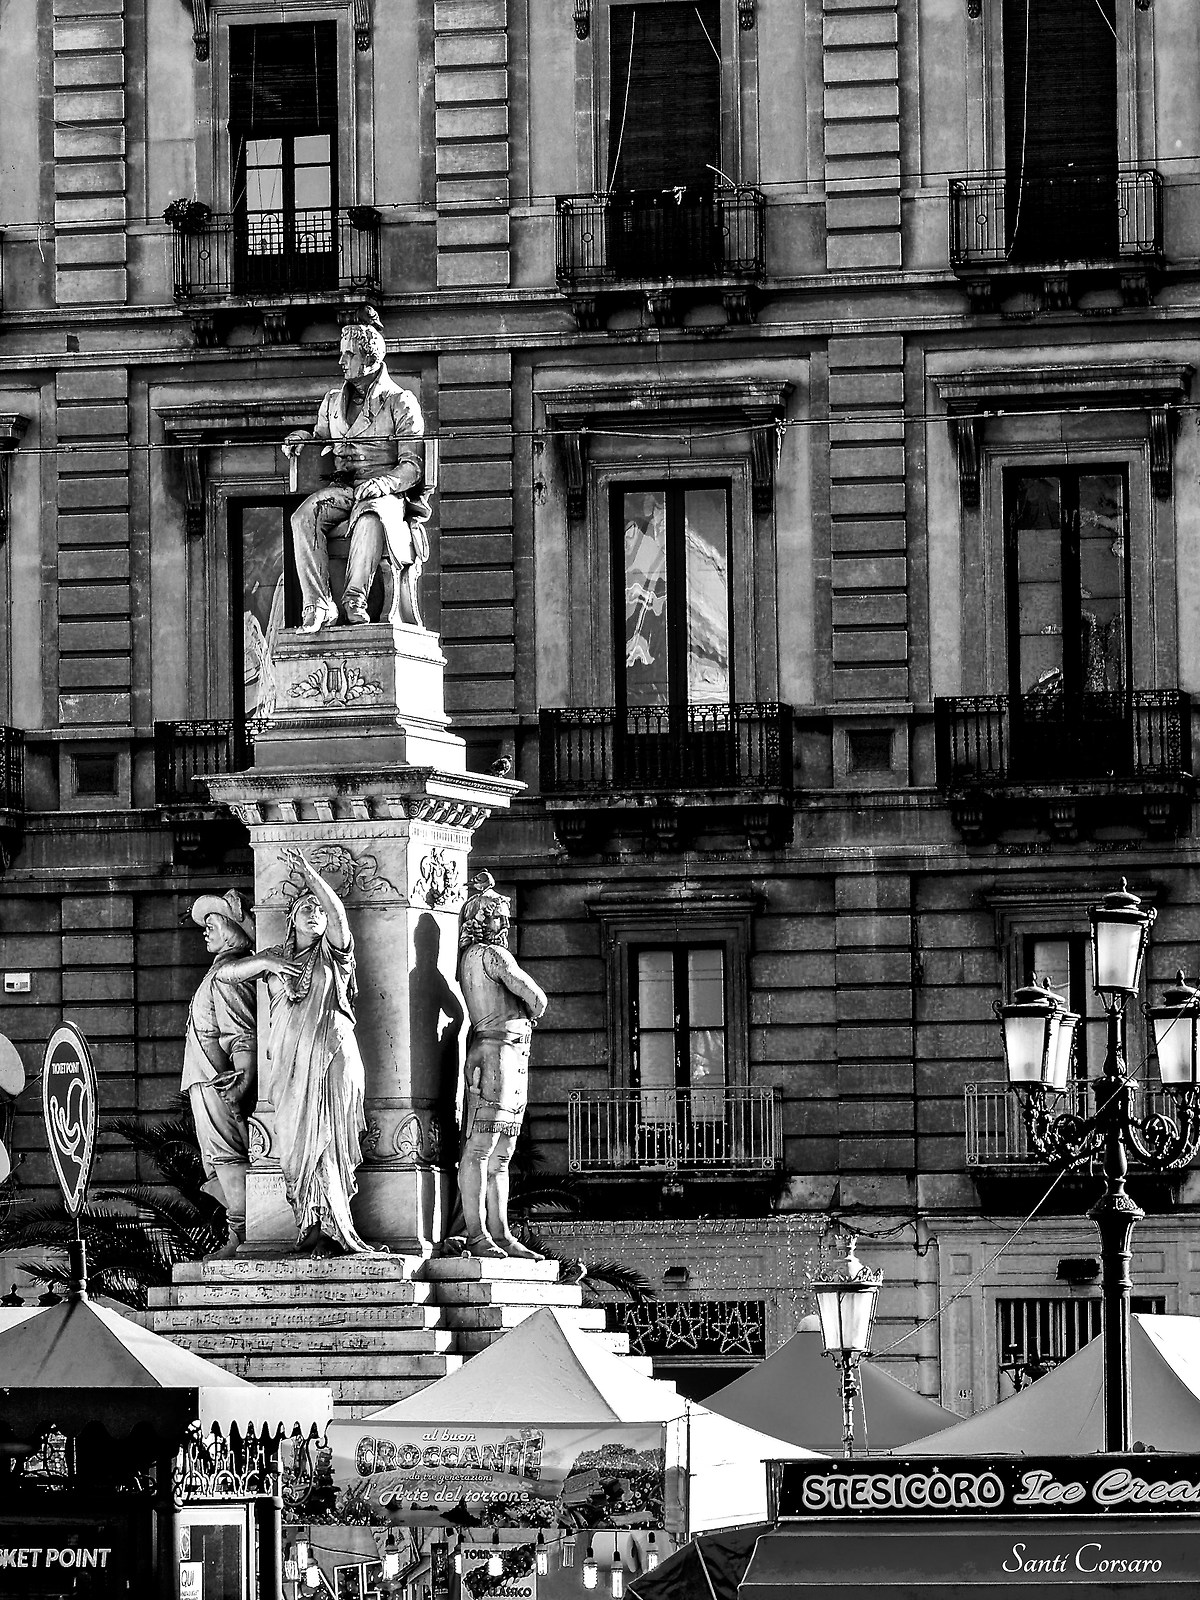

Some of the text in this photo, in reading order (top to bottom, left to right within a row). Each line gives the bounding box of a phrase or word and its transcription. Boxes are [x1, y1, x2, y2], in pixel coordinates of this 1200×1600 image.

[422, 1428, 476, 1441] al buon
[355, 1435, 544, 1481] CROCCANTE
[434, 1485, 460, 1502] del
[464, 1489, 530, 1502] torrone
[803, 1468, 1200, 1509] STESICORO Ice Crea
[46, 1548, 112, 1568] POINT
